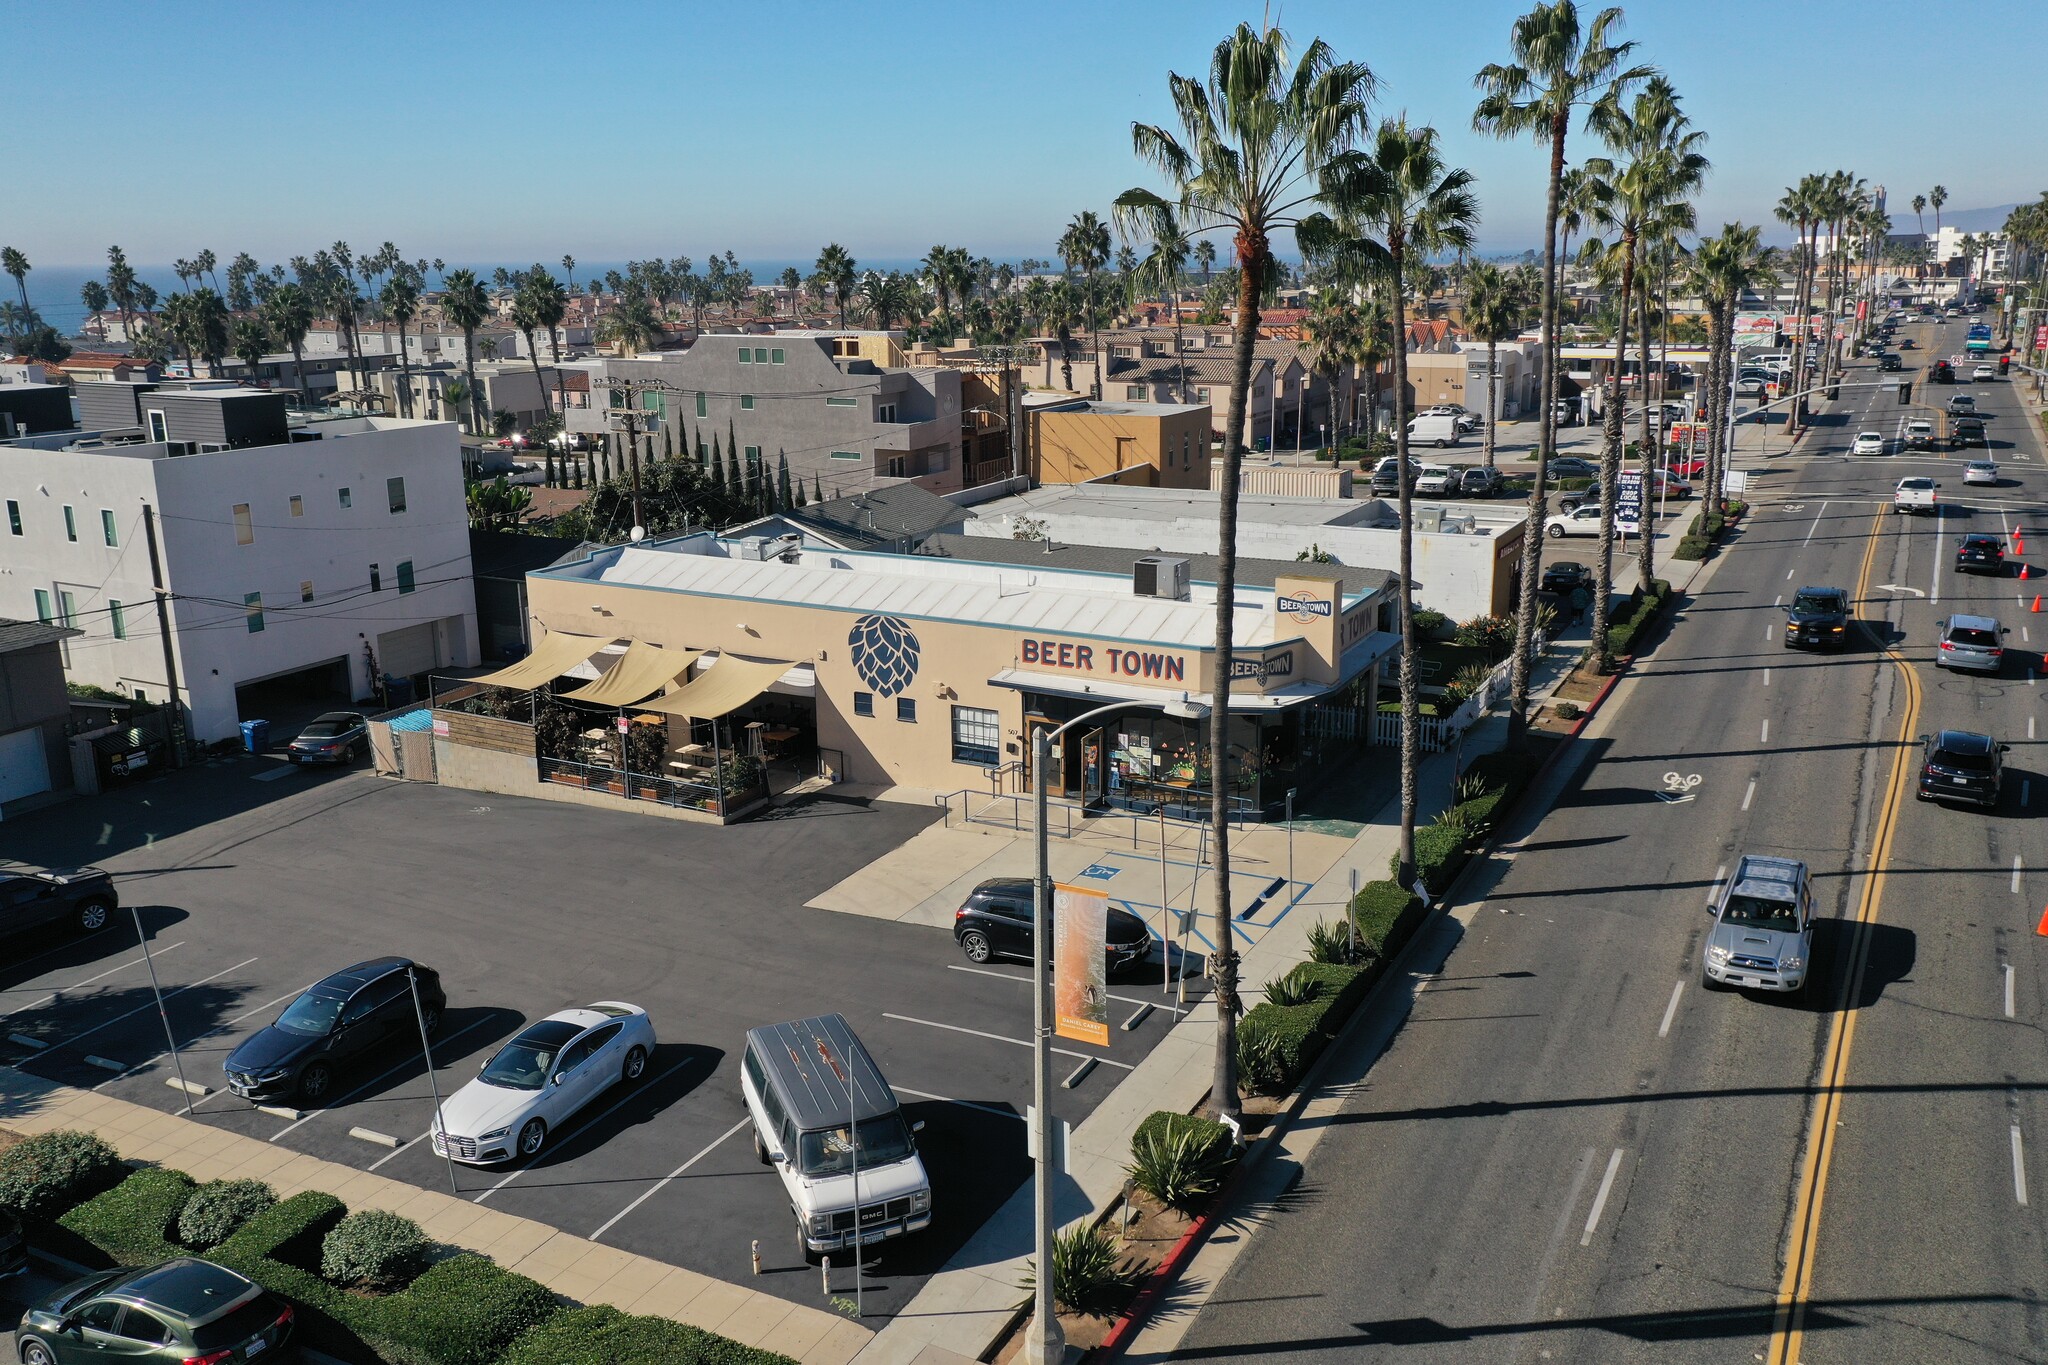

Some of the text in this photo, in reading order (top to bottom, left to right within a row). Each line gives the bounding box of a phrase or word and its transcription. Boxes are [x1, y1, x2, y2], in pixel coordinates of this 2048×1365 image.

[1280, 599, 1329, 614] BEER TOWN
[1347, 606, 1372, 641] TOWN
[1021, 638, 1185, 682] BEER TOWN
[1266, 654, 1290, 673] TOWN
[1062, 1017, 1082, 1027] DANIEL
[862, 1210, 883, 1220] GMC
